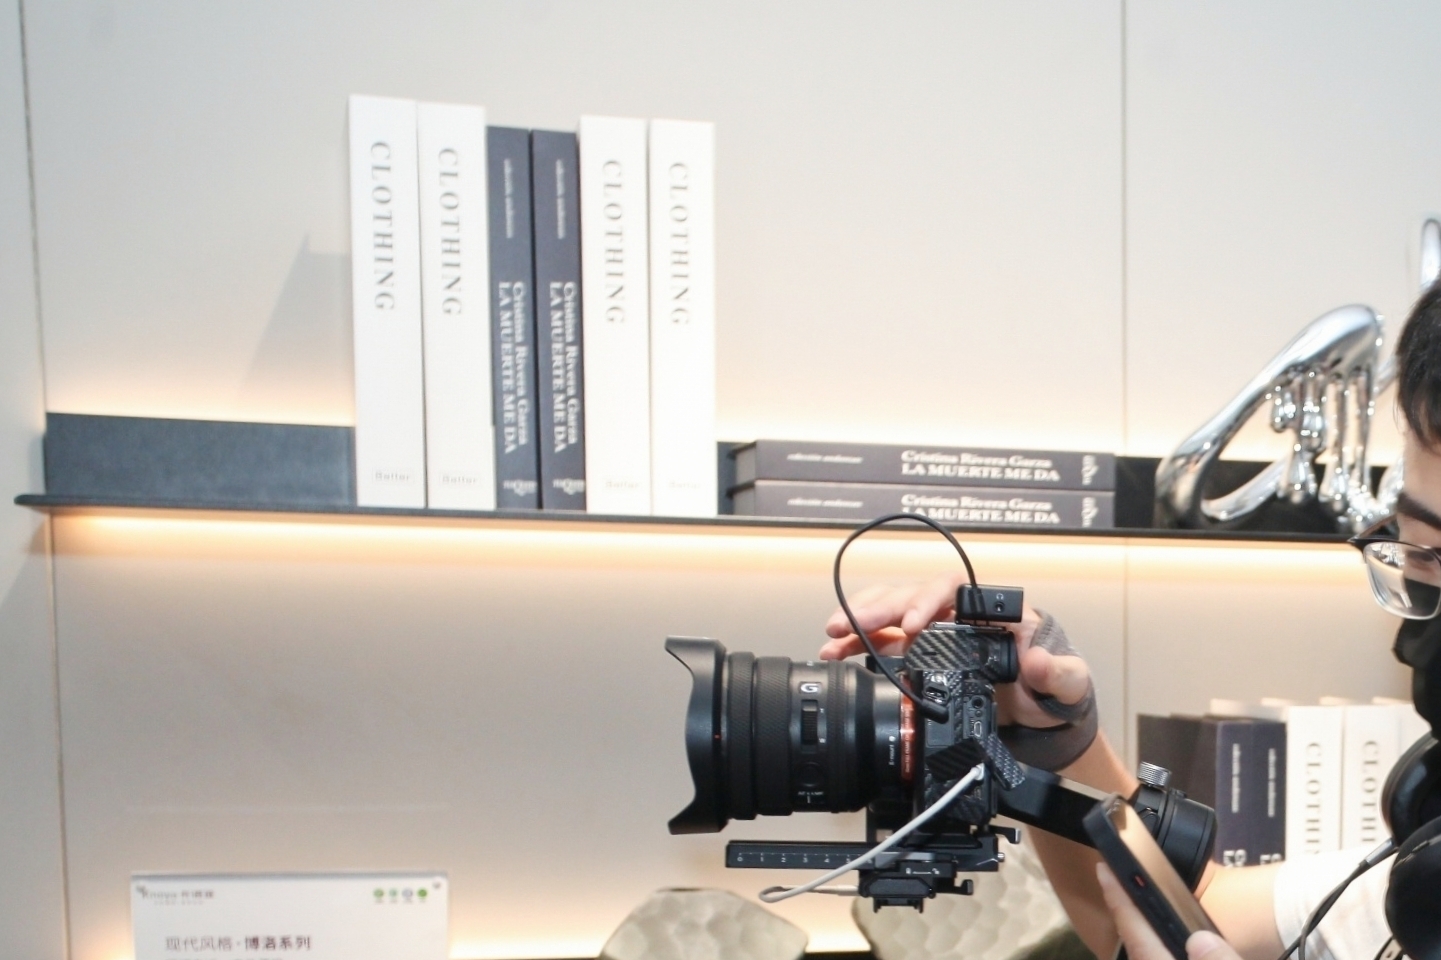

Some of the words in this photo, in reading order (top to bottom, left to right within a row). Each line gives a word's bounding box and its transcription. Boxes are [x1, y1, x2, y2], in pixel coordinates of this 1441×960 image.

[370, 141, 395, 310] CLOTHING
[438, 148, 462, 315] CLOTHING
[603, 160, 625, 324] CLOTHING
[669, 163, 690, 325] CLOTHING
[499, 281, 512, 307] LA
[550, 281, 563, 307] LA
[500, 310, 514, 391] MUERTE
[550, 310, 564, 391] MUERTE
[503, 393, 517, 424] ME
[553, 393, 567, 424] ME
[504, 426, 518, 454] DA
[554, 426, 568, 453] DA
[901, 450, 959, 465] Cristina
[960, 453, 1008, 467] Rivera
[1009, 455, 1053, 469] Garza
[901, 462, 926, 476] LA
[927, 464, 1003, 478] MUERTE
[1004, 468, 1034, 480] ME
[1034, 469, 1061, 482] DA
[901, 494, 959, 508] Cristina
[960, 496, 1008, 509] Rivera
[1009, 498, 1053, 511] Garza
[927, 507, 1003, 522] MUERTE
[1004, 511, 1034, 523] ME
[1034, 512, 1061, 524] DA
[801, 683, 819, 693] G
